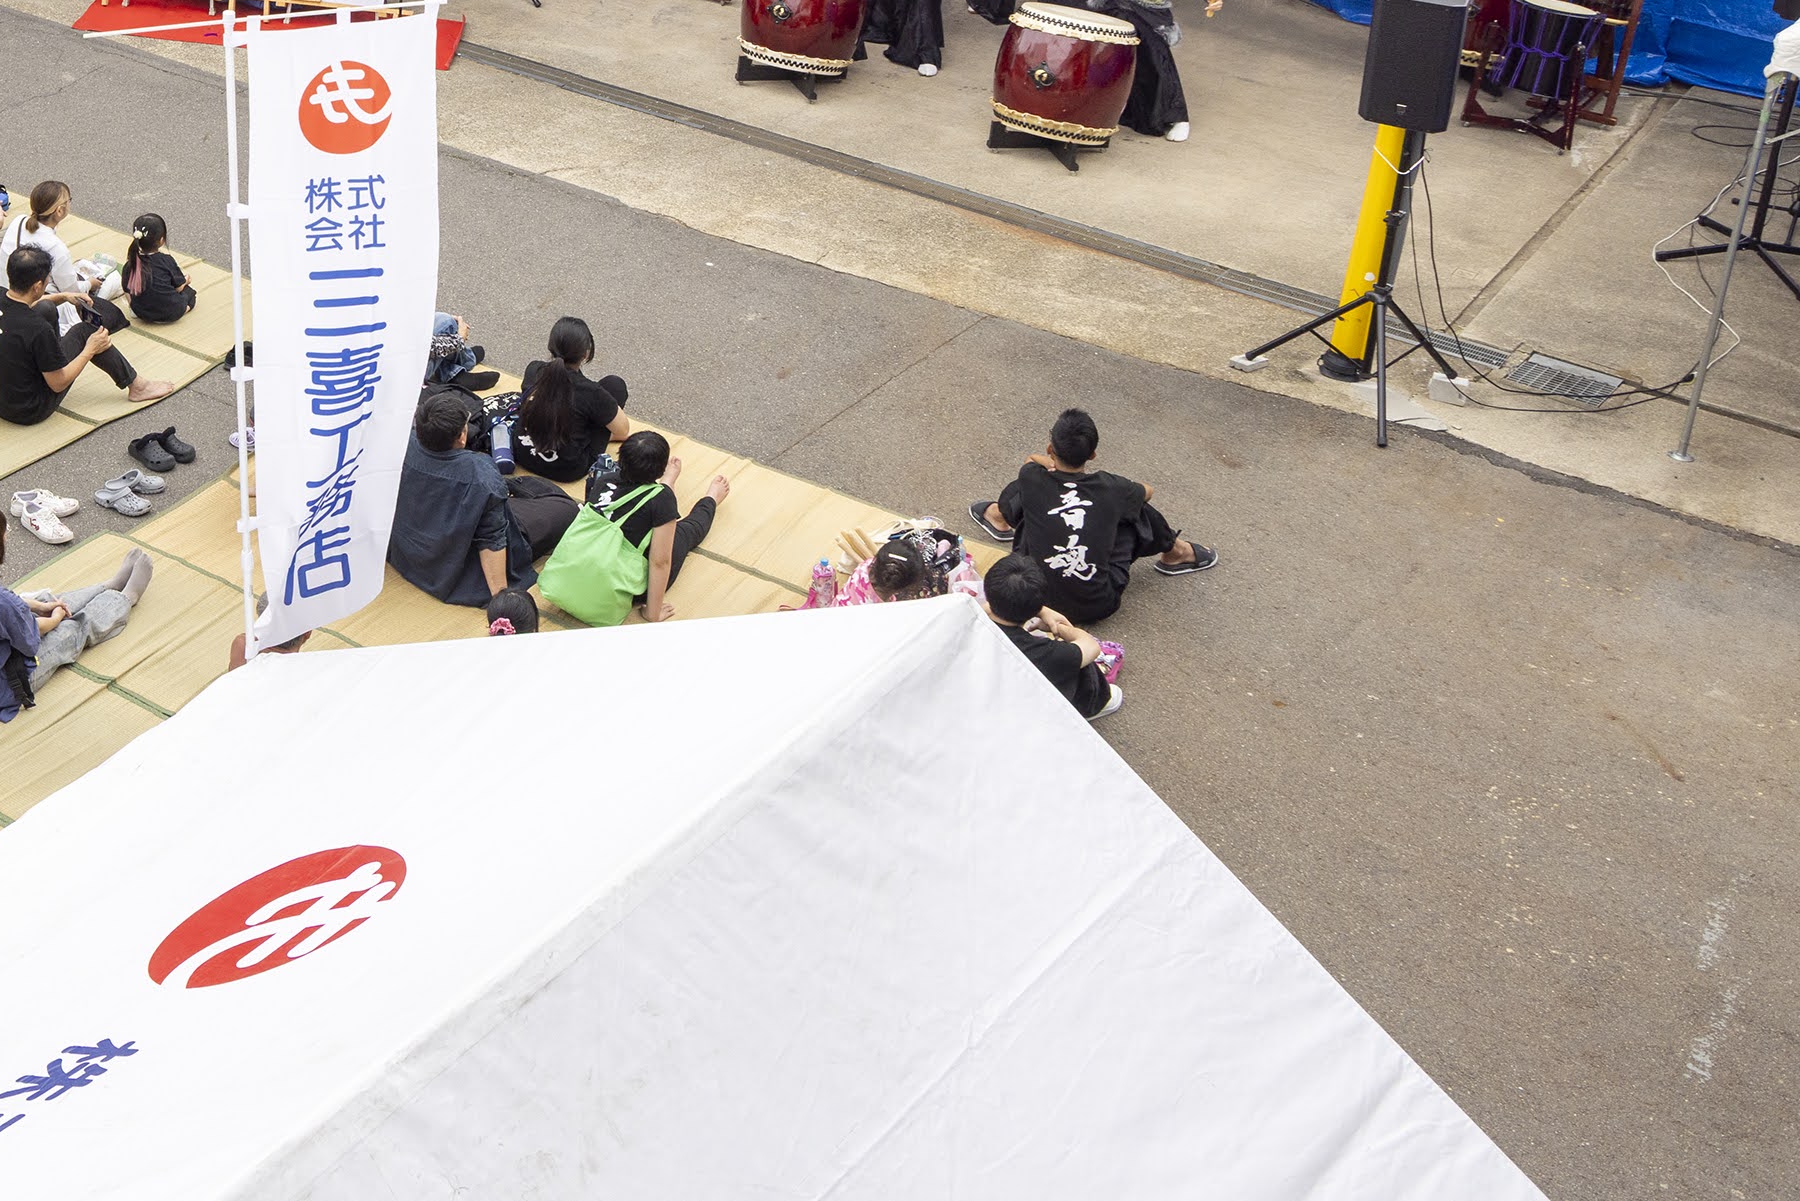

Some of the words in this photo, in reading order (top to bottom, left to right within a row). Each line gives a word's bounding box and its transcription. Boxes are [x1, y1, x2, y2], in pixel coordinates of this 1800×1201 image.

[284, 266, 388, 605] 三喜工務店
